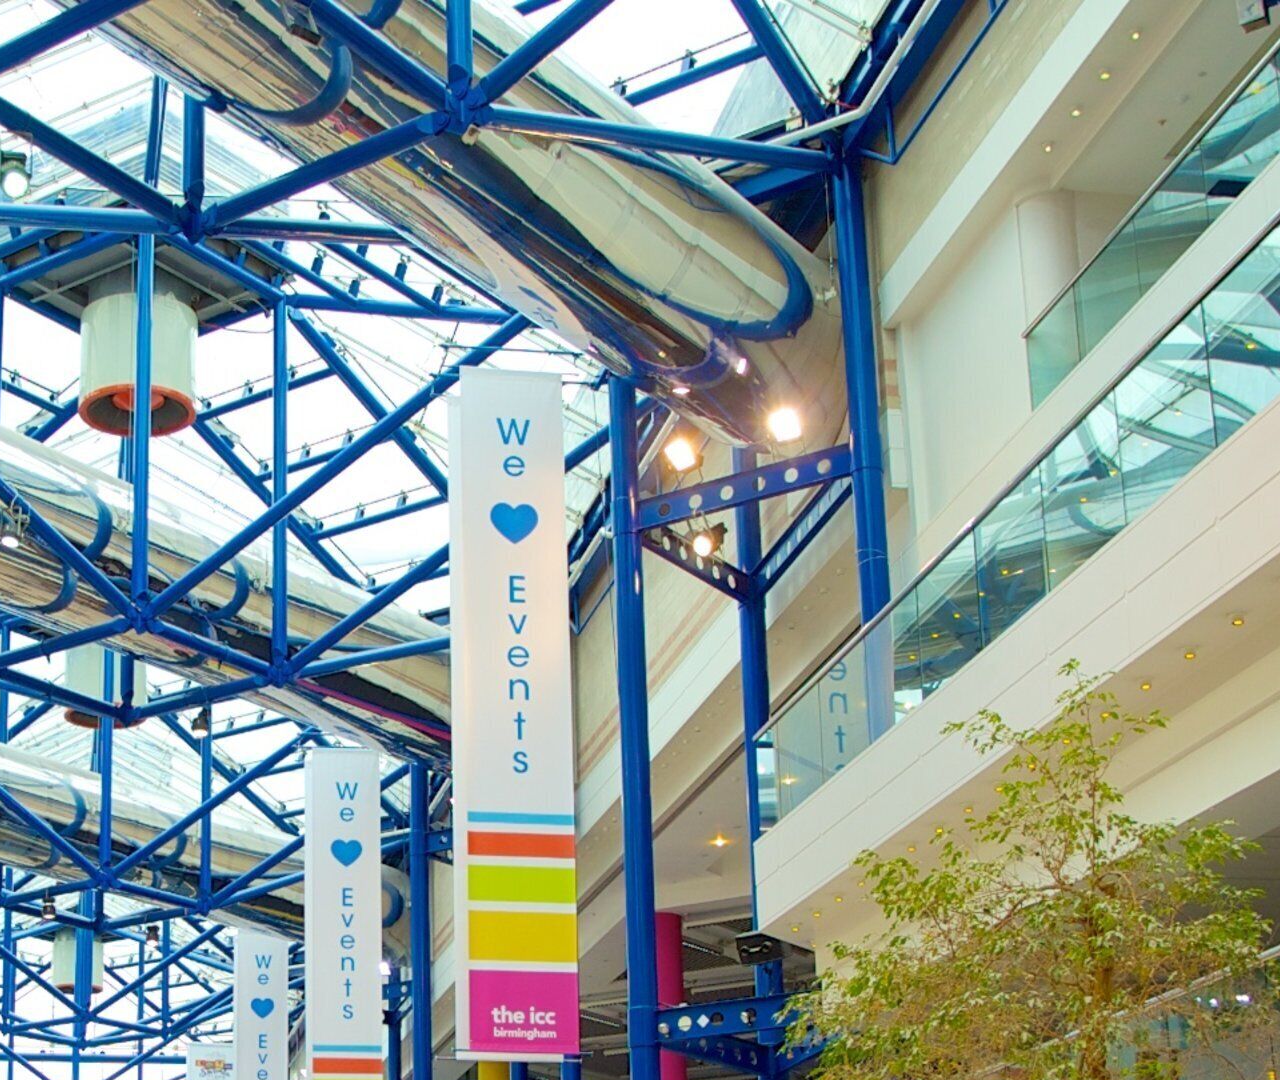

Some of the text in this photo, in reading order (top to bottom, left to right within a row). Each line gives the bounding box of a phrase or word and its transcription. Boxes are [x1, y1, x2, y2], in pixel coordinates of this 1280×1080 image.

[496, 417, 531, 774] We Events
[335, 781, 358, 1021] We Events
[254, 953, 273, 986] We
[492, 1005, 556, 1026] the icc
[493, 1025, 557, 1041] birmingham
